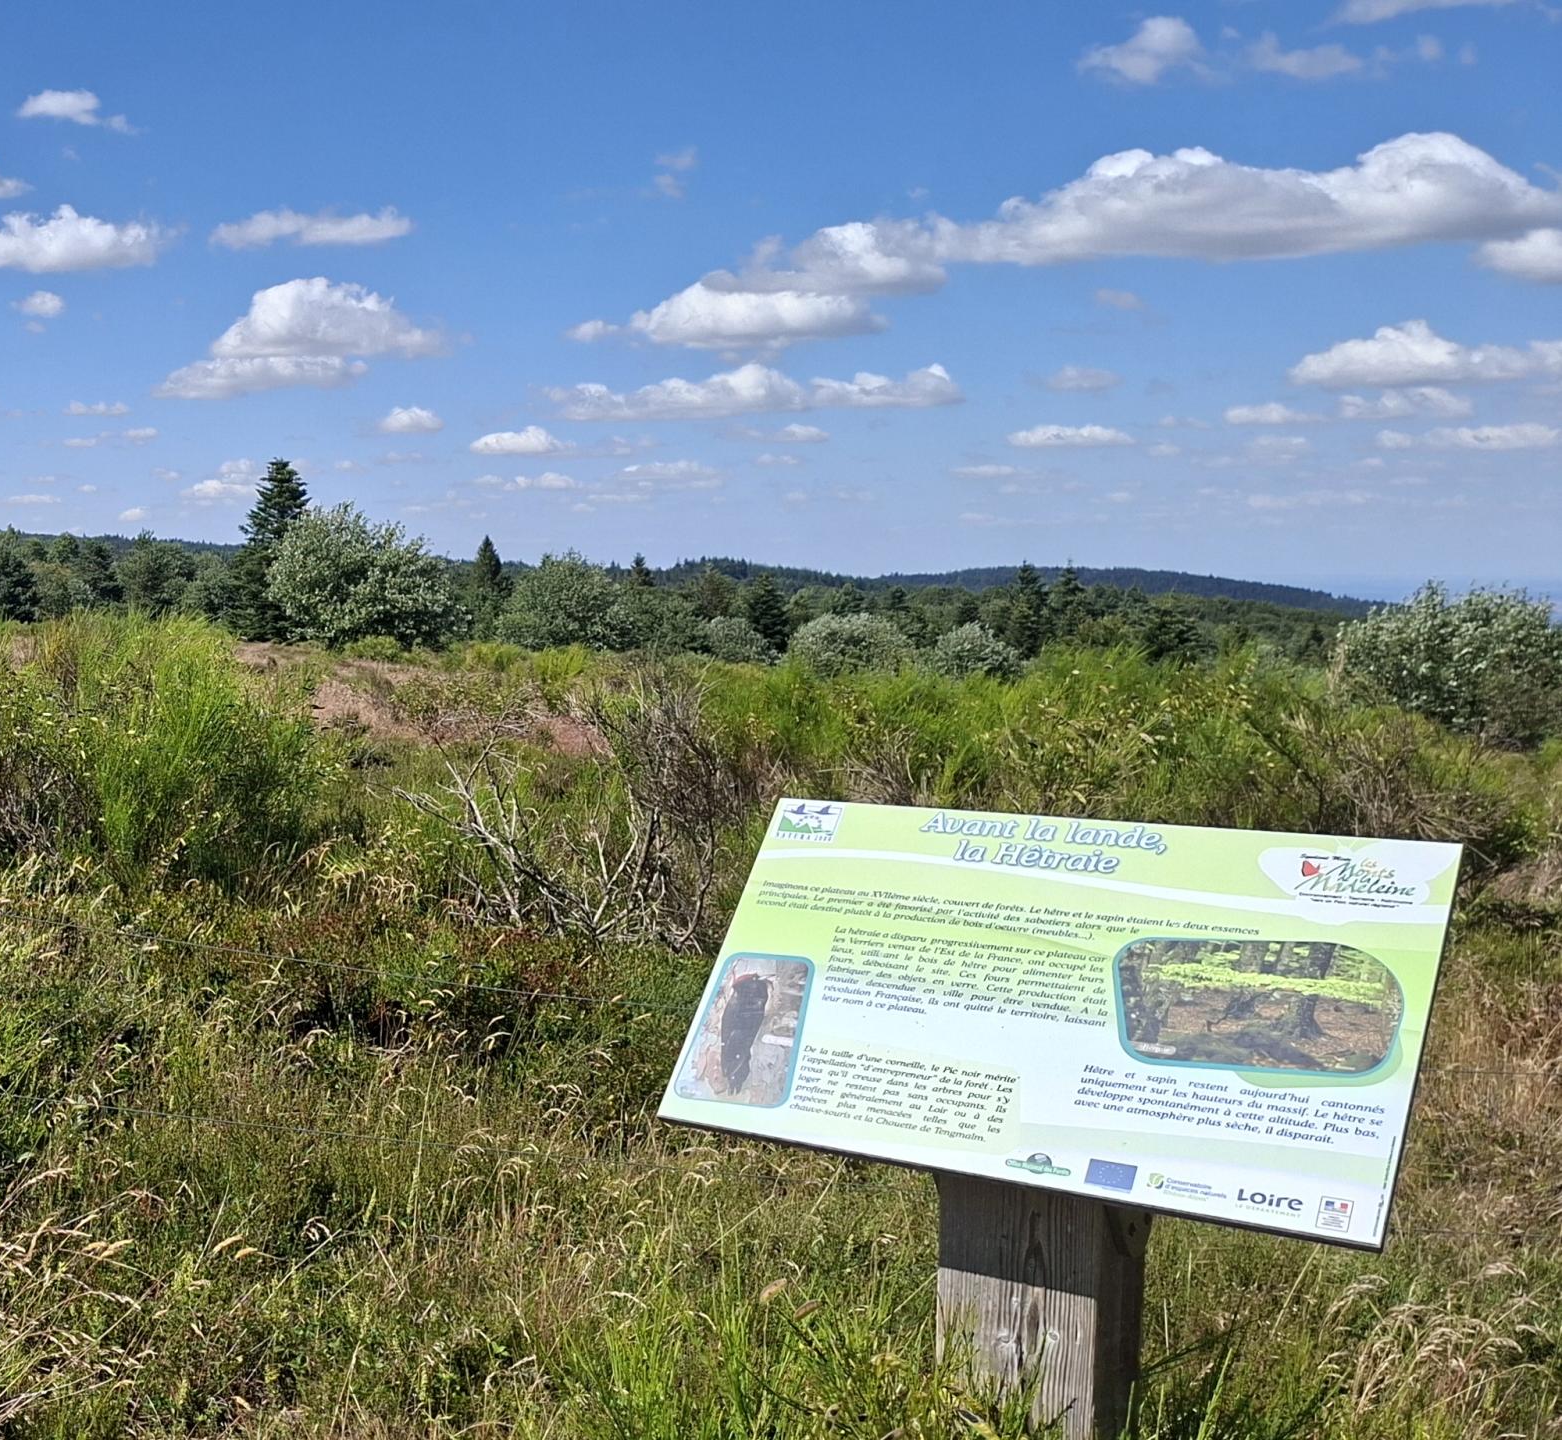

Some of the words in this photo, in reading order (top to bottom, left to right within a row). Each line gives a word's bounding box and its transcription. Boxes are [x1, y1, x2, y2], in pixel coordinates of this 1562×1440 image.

[920, 812, 1019, 838] Avant
[1024, 818, 1056, 842] la
[1064, 822, 1167, 855] lande,
[953, 840, 986, 862] la
[992, 843, 1120, 874] Hêtraie
[1325, 862, 1396, 879] Monts
[1294, 873, 1416, 897] Madeleine
[1081, 1077, 1147, 1092] uniquement
[1150, 1087, 1169, 1096] sur
[1192, 1091, 1243, 1106] hauteurs
[1247, 1099, 1263, 1109] du
[1146, 1075, 1177, 1085] sapin
[1188, 1081, 1229, 1092] restent
[1074, 1099, 1100, 1108] avec
[1103, 1103, 1124, 1112] une
[1197, 1116, 1222, 1126] plus
[1235, 1111, 1265, 1121] cette
[1323, 1123, 1349, 1134] Plus
[1237, 1188, 1303, 1211] Loire
